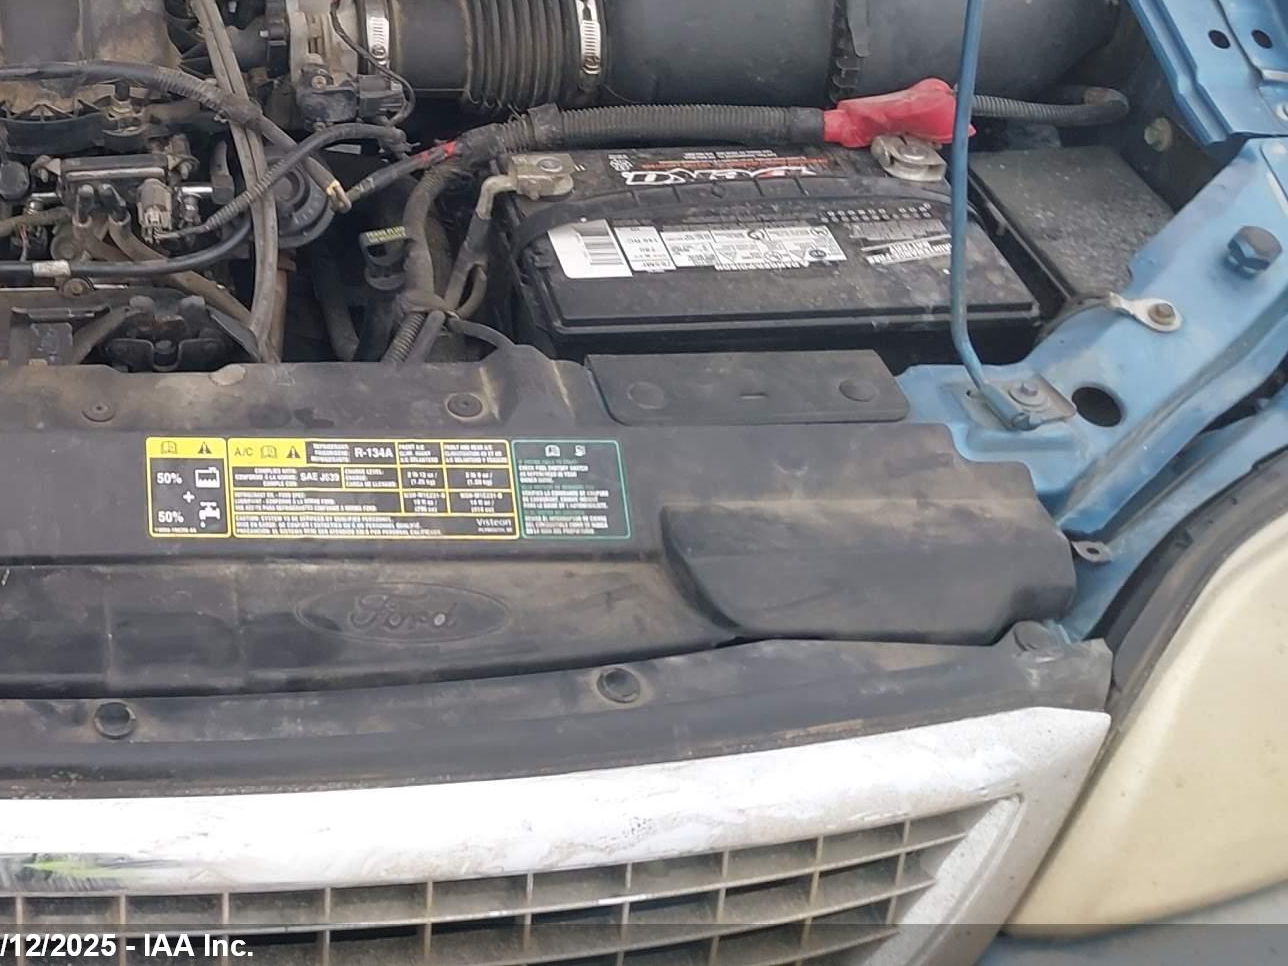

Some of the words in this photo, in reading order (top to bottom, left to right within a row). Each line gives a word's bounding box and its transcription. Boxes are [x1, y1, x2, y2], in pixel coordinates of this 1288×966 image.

[234, 446, 254, 458] A/C
[353, 447, 394, 458] R-134A
[156, 472, 183, 485] 50%
[300, 472, 318, 482] SAE
[158, 510, 185, 524] 50%
[475, 518, 512, 527] Visteon
